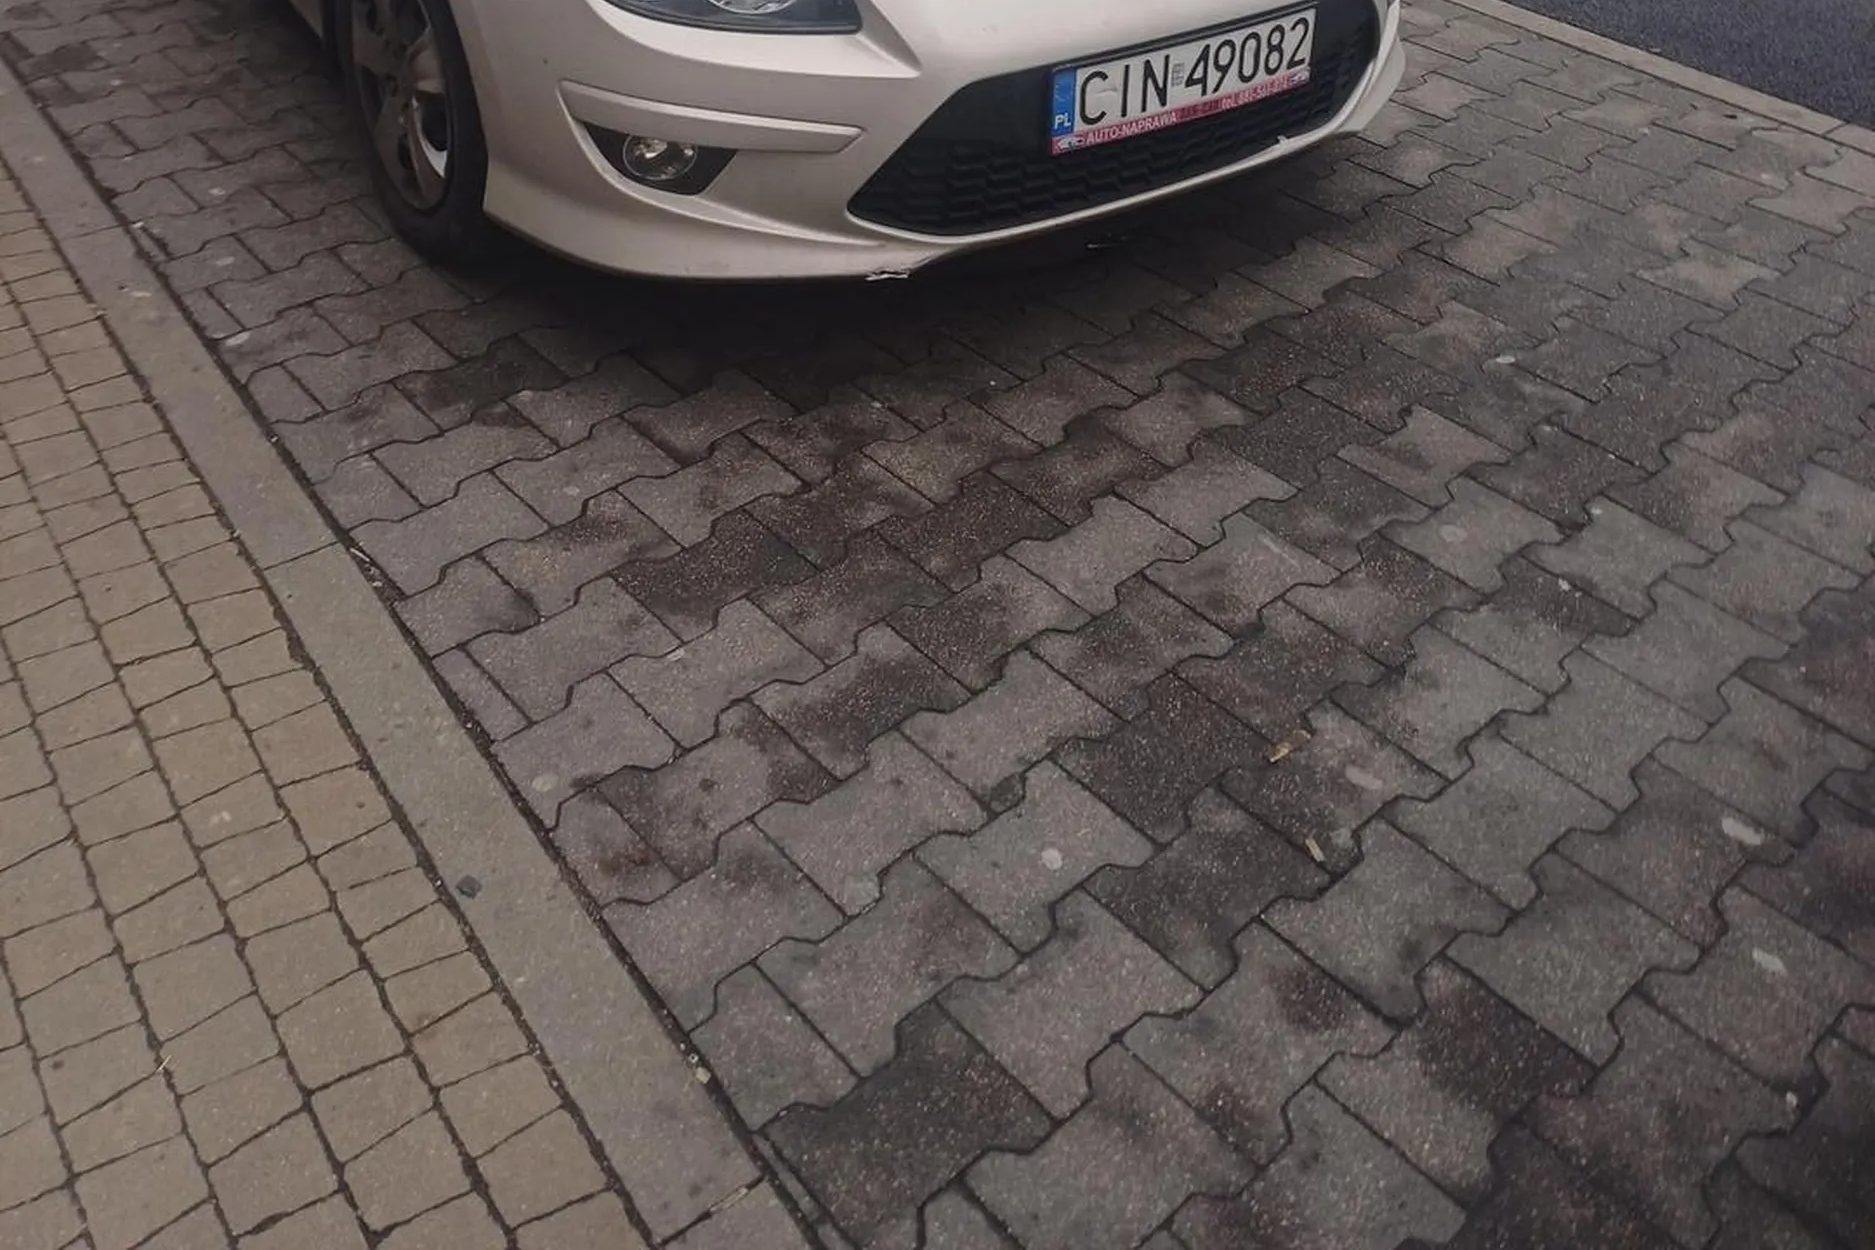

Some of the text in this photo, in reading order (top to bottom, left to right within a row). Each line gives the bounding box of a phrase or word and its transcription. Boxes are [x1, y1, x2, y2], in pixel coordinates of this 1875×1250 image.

[1080, 54, 1170, 126] CIN
[1183, 17, 1310, 97] 49082
[1053, 112, 1072, 130] PL
